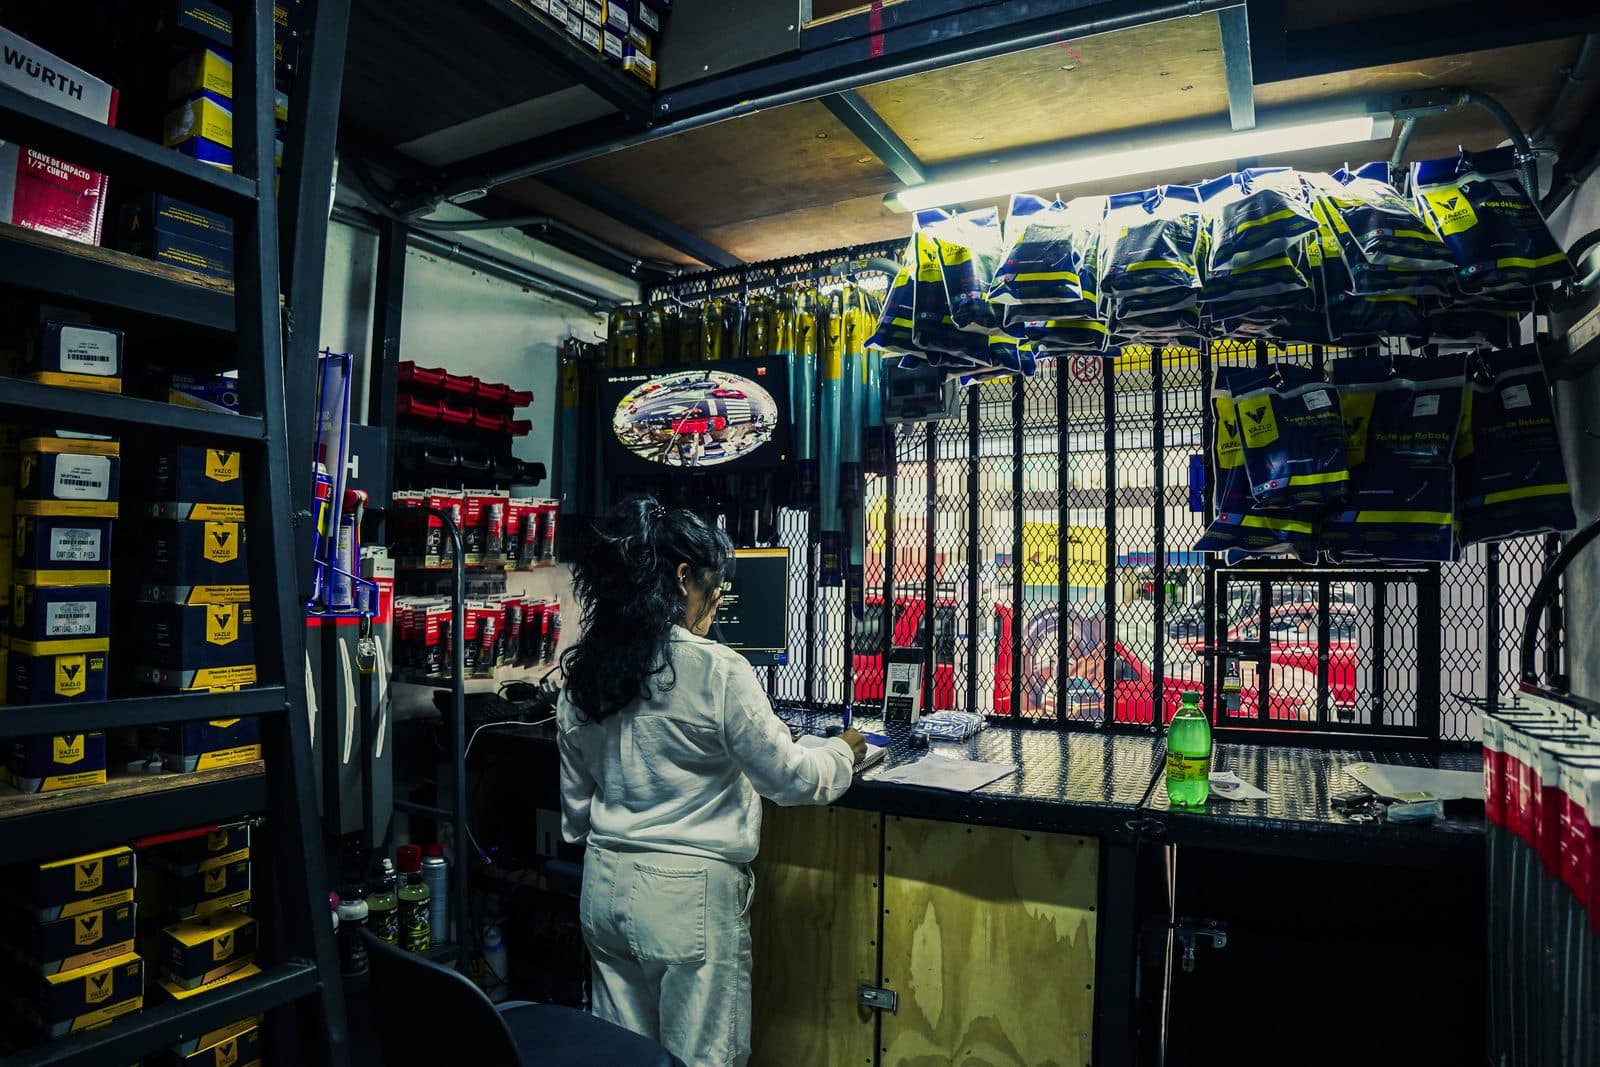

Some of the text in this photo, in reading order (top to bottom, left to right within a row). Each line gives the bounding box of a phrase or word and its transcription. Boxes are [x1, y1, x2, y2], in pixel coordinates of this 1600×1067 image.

[4, 46, 83, 100] WÜRTH
[28, 149, 90, 180] CHAVE DE IMPACTO
[28, 157, 68, 181] 1/2" CURTA
[1248, 423, 1272, 434] VAZLO
[79, 877, 99, 886] VAZLO
